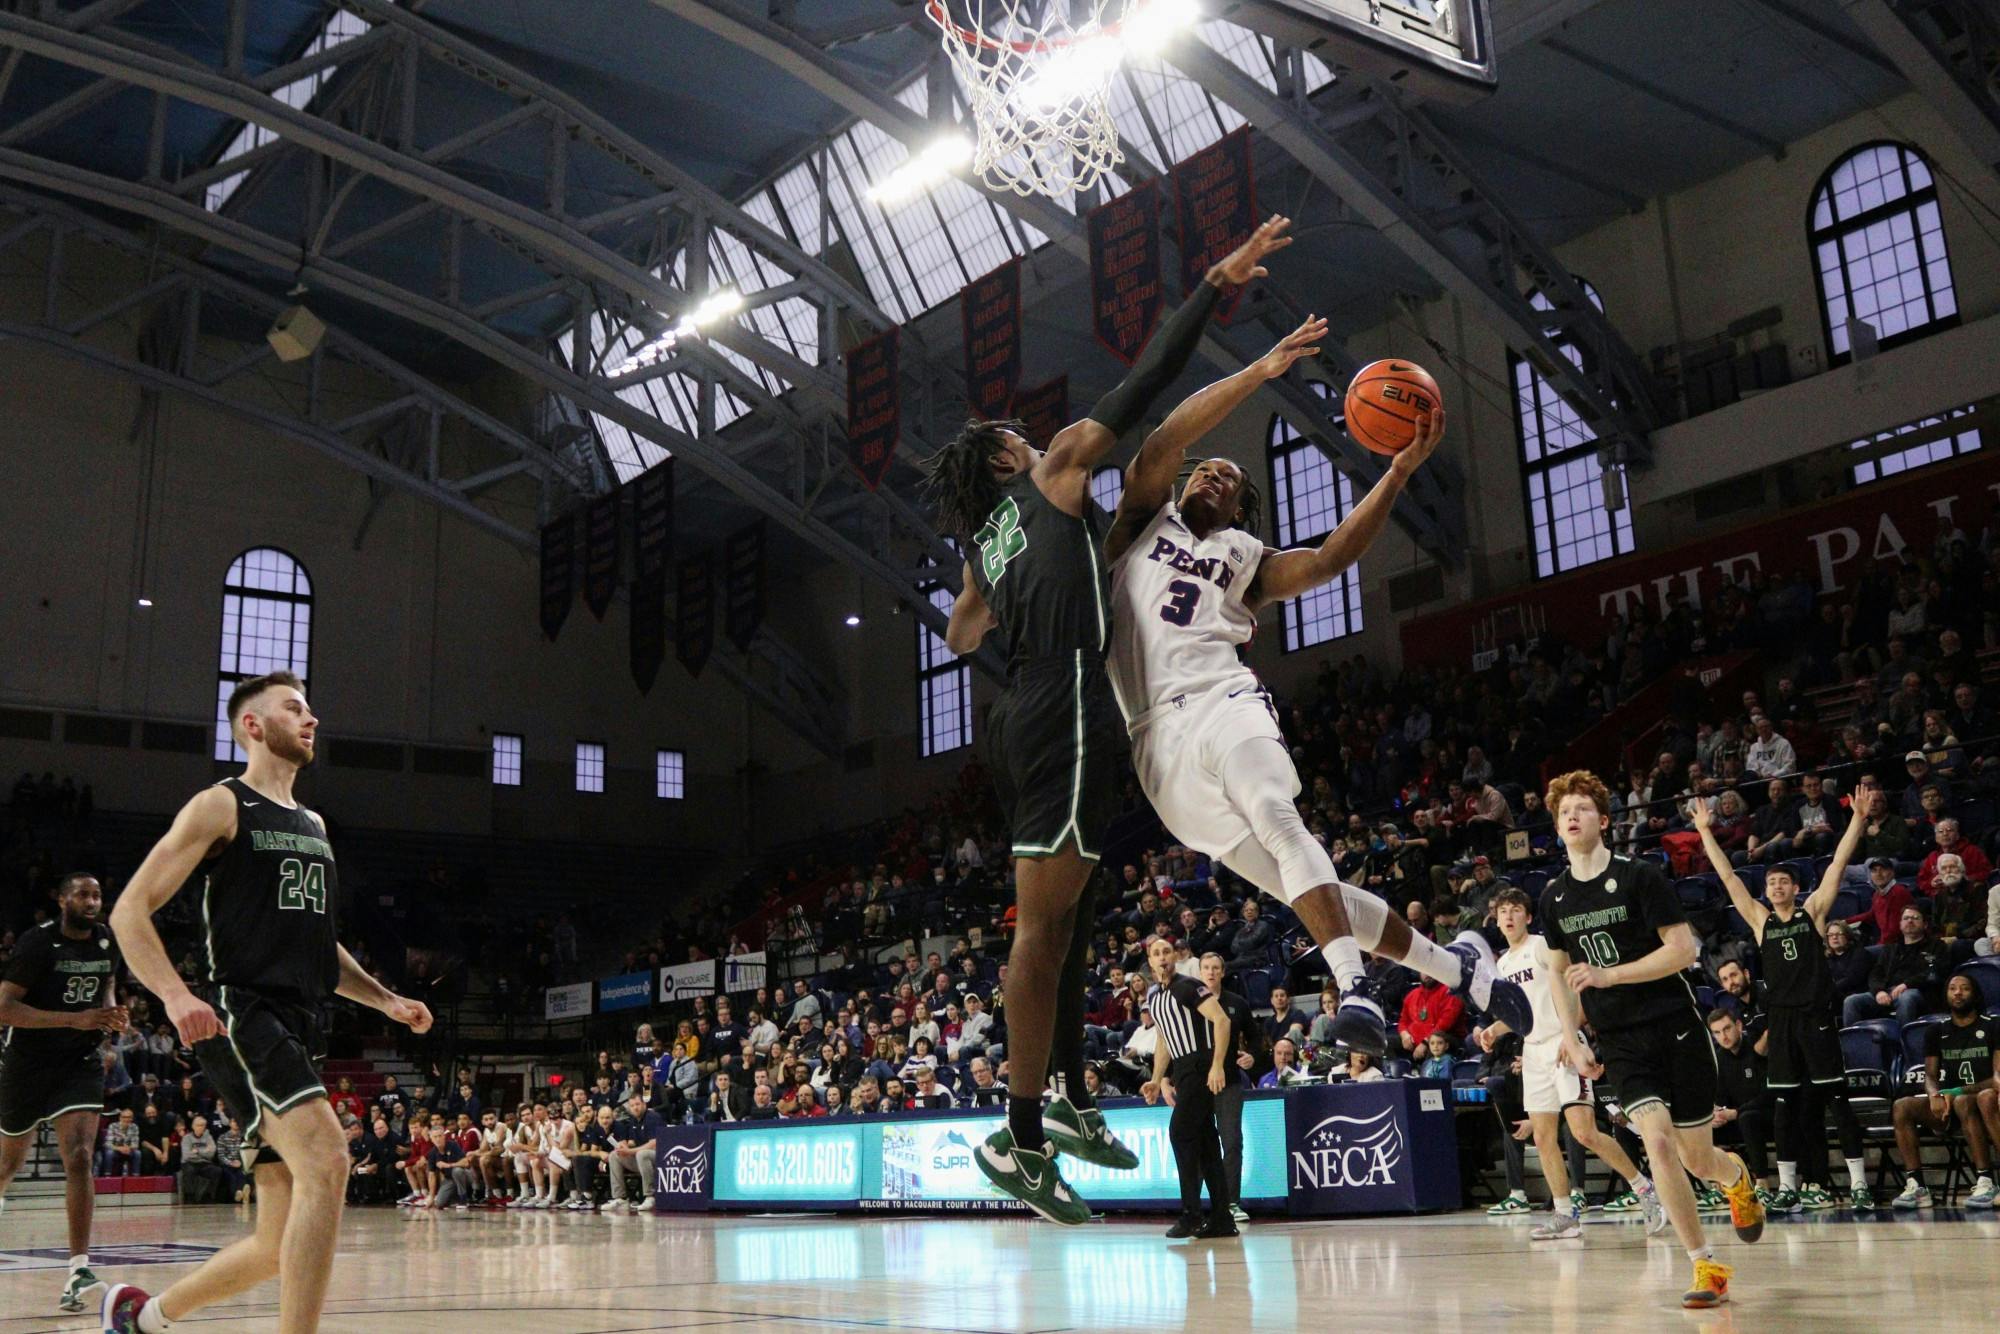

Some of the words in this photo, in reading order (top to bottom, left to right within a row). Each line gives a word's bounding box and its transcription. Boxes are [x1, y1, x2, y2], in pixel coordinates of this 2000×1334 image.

[1383, 384, 1430, 413] ELITE
[974, 496, 1027, 590] 22
[1148, 536, 1234, 592] PENN
[1600, 551, 1762, 625] THE
[1160, 579, 1202, 627] 3
[1508, 838, 1526, 850] 104
[278, 858, 326, 914] 24
[1579, 931, 1620, 968] 10
[1782, 938, 1798, 960] 3
[63, 976, 99, 1003] 32
[1848, 1074, 1883, 1087] ENN
[1905, 1069, 1947, 1083] PEN
[1958, 1061, 1974, 1084] 4
[738, 1141, 855, 1185] 856.320.6013
[933, 1155, 970, 1169] SJPR
[1291, 1144, 1396, 1190] NECA
[657, 1166, 702, 1194] NECA
[860, 1201, 889, 1209] WELCOME
[892, 1201, 901, 1209] TO
[905, 1201, 942, 1209] MACQUARIE
[946, 1201, 968, 1209] COURT
[972, 1201, 981, 1209] AT
[985, 1201, 999, 1209] THE
